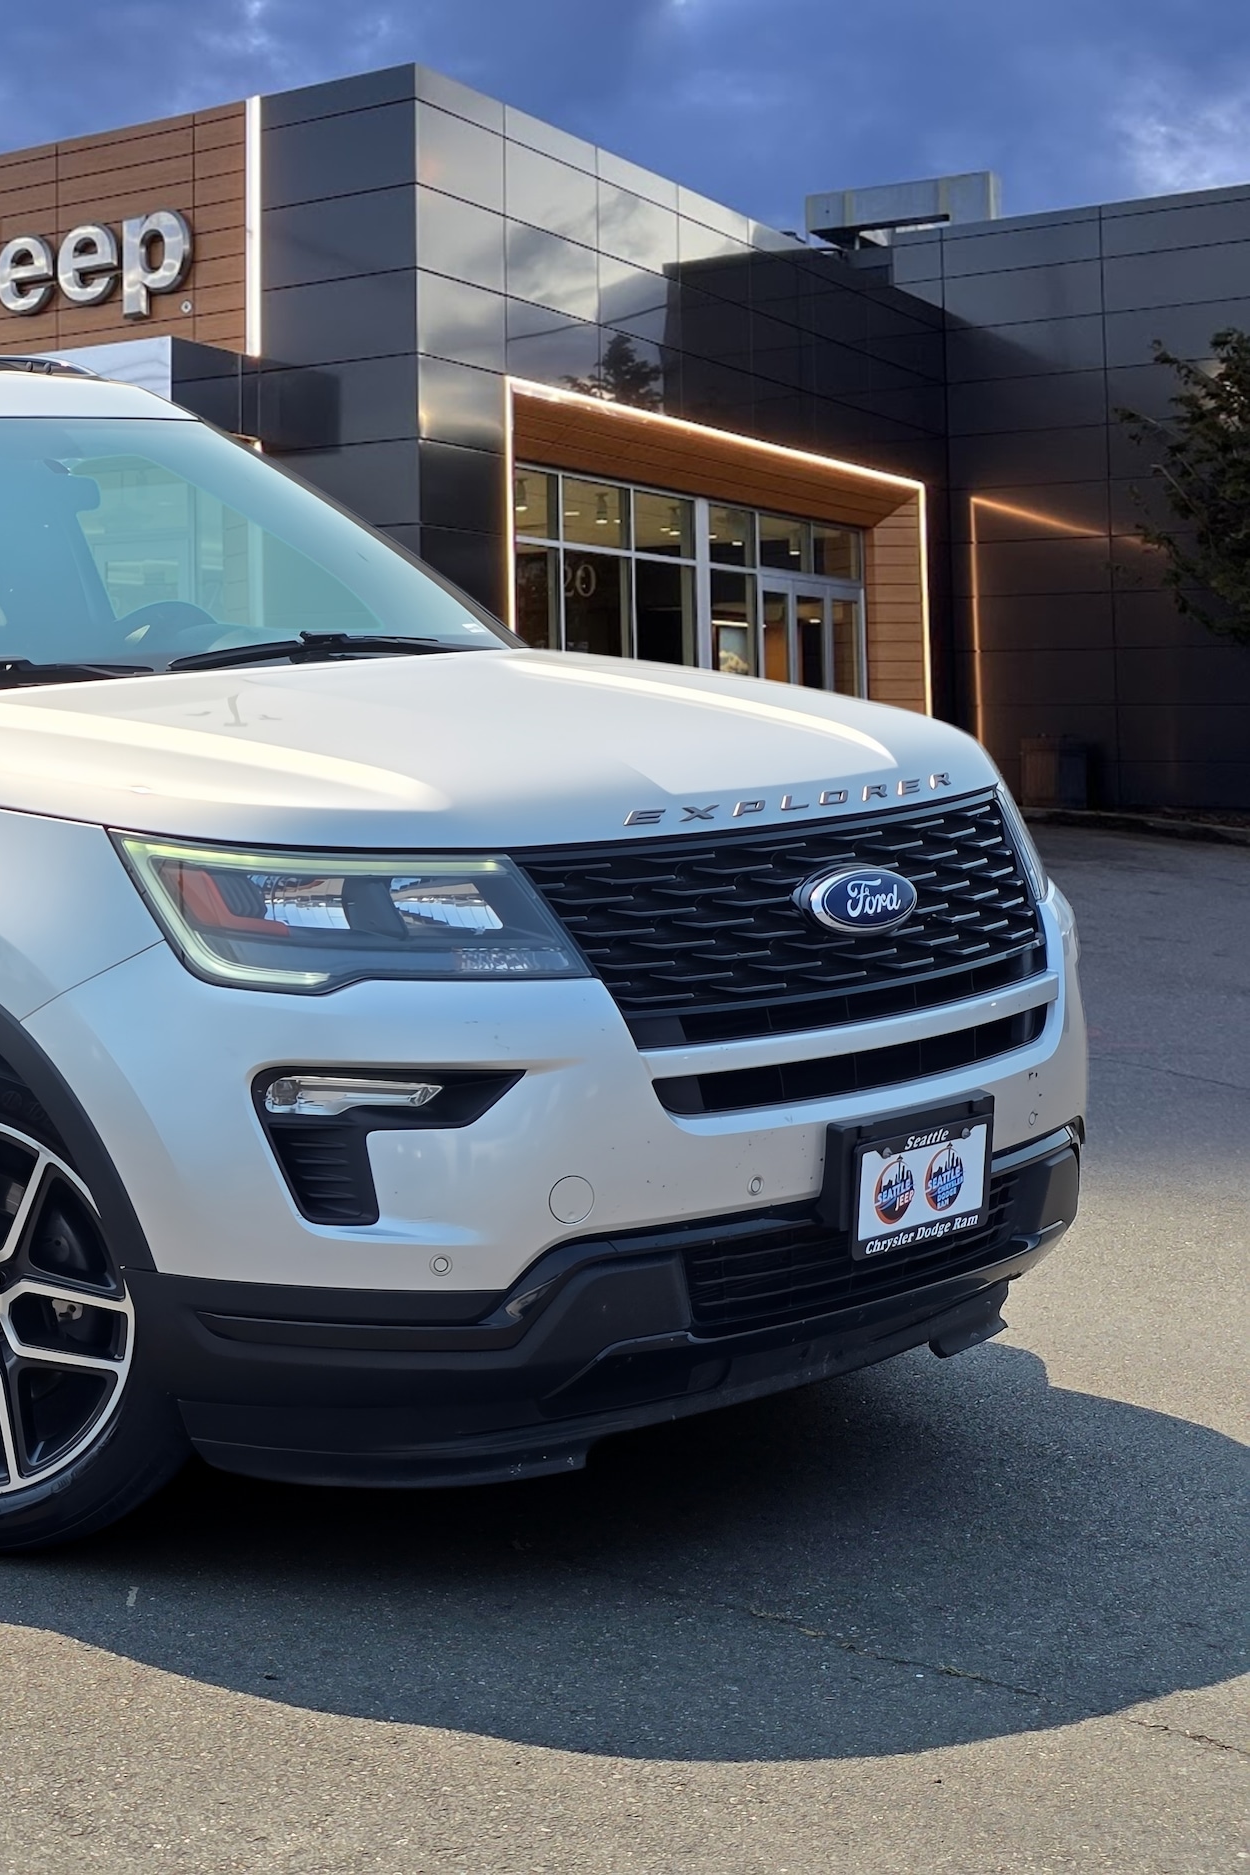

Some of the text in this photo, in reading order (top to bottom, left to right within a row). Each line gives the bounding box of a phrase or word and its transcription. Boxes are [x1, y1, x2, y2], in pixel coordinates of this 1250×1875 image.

[623, 772, 952, 826] EXPLORER
[846, 878, 902, 918] Ford
[904, 1128, 949, 1151] Seattle
[927, 1165, 963, 1190] SEATTLE
[877, 1178, 913, 1202] SEATTLE
[894, 1189, 914, 1212] JEEP
[937, 1187, 957, 1202] DODGE
[865, 1214, 979, 1255] Chrysler Dodge Ram
